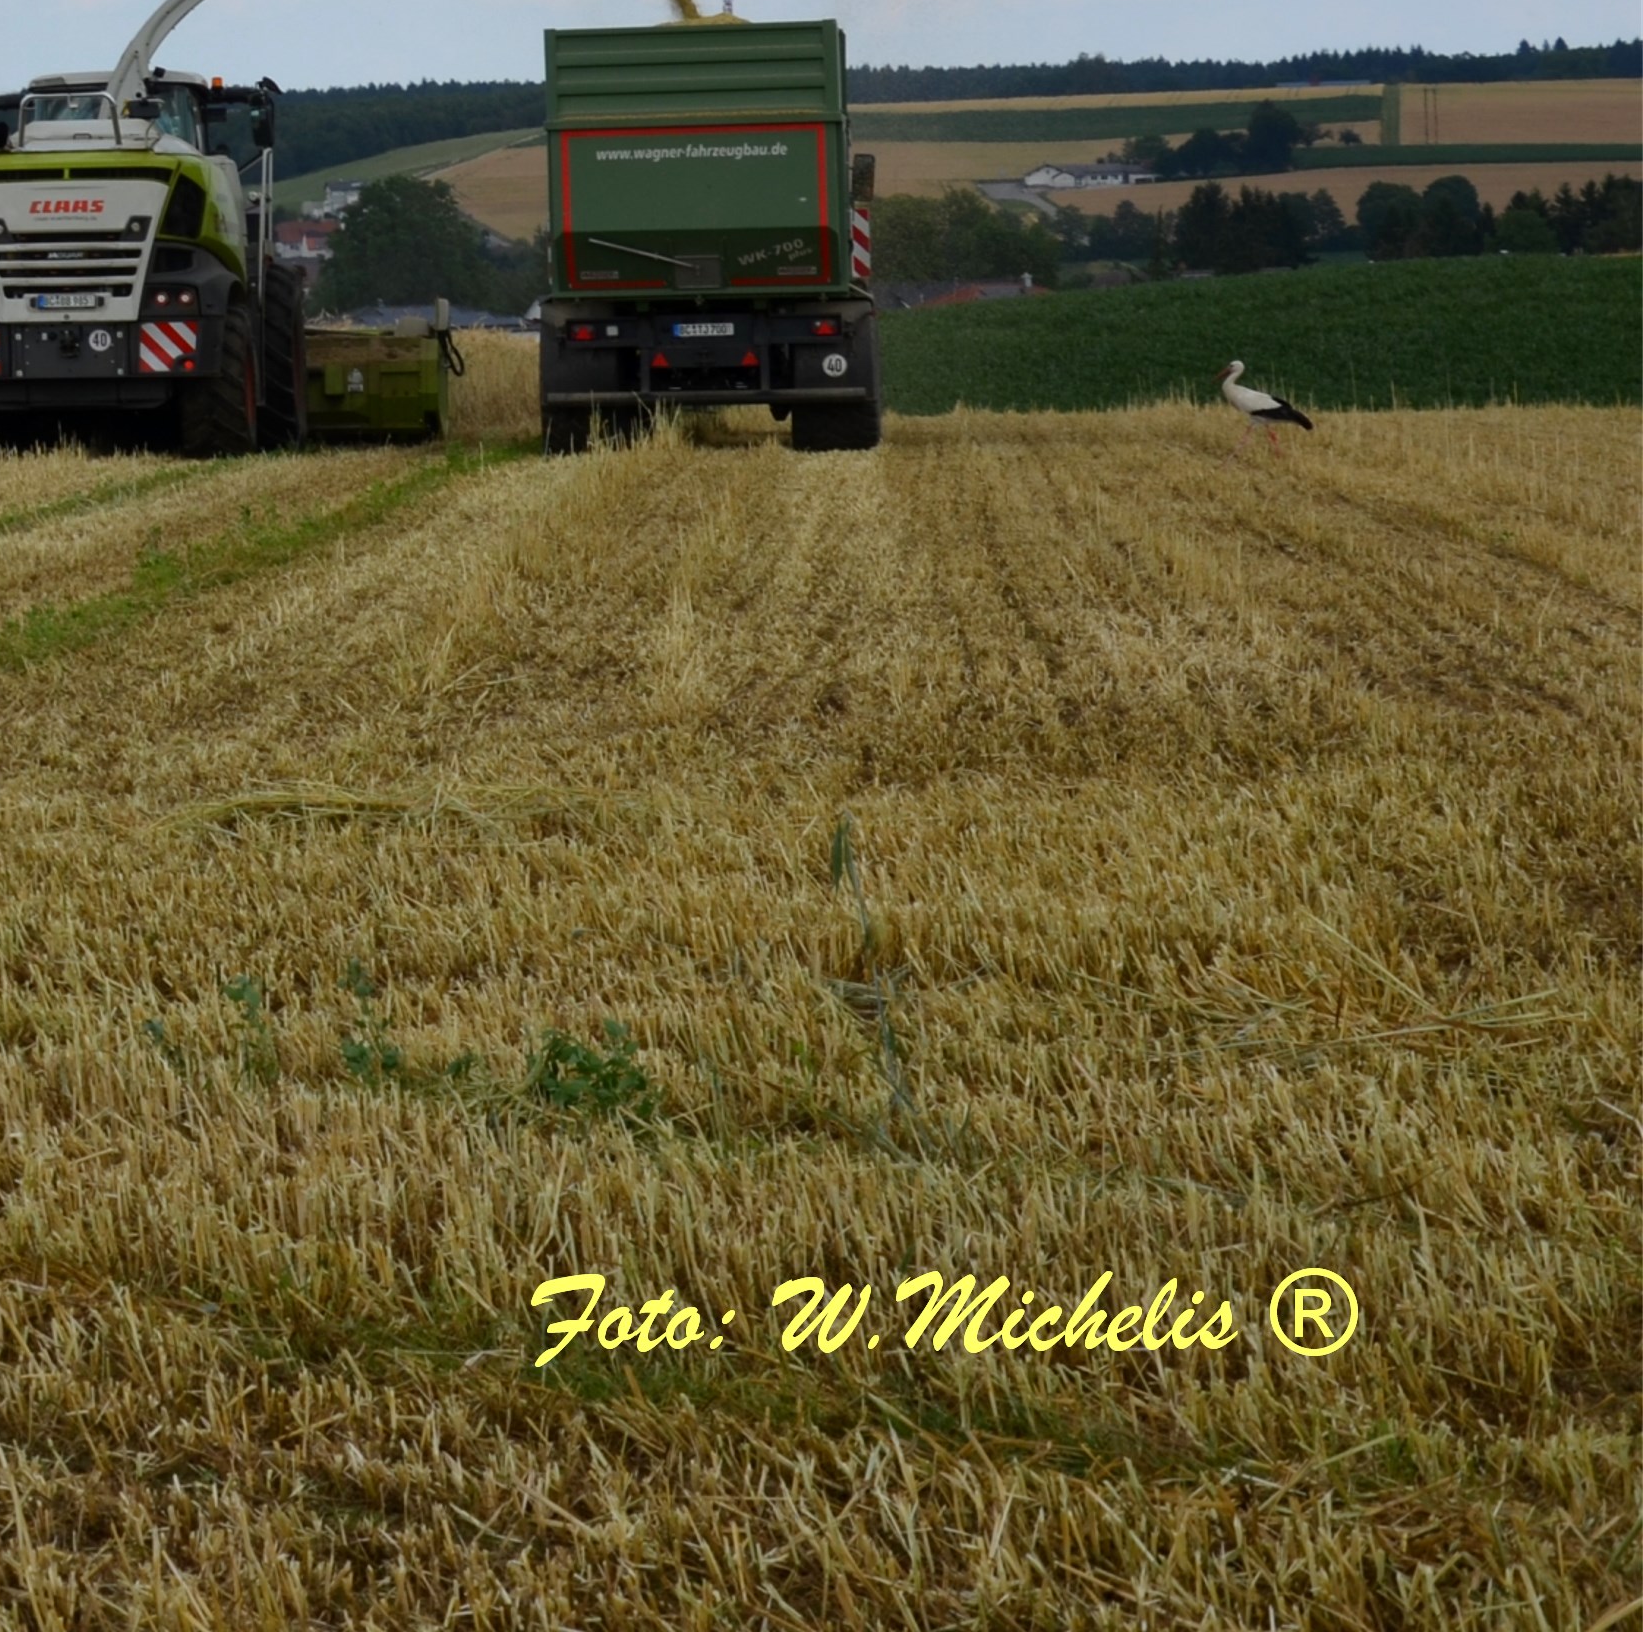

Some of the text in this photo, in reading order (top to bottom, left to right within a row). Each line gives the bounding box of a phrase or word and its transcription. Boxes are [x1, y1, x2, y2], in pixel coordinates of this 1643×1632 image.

[595, 142, 788, 162] www.wagner-fahrzeugbau.de
[28, 199, 105, 215] CLAAS
[92, 332, 108, 347] 40
[827, 357, 843, 372] 40
